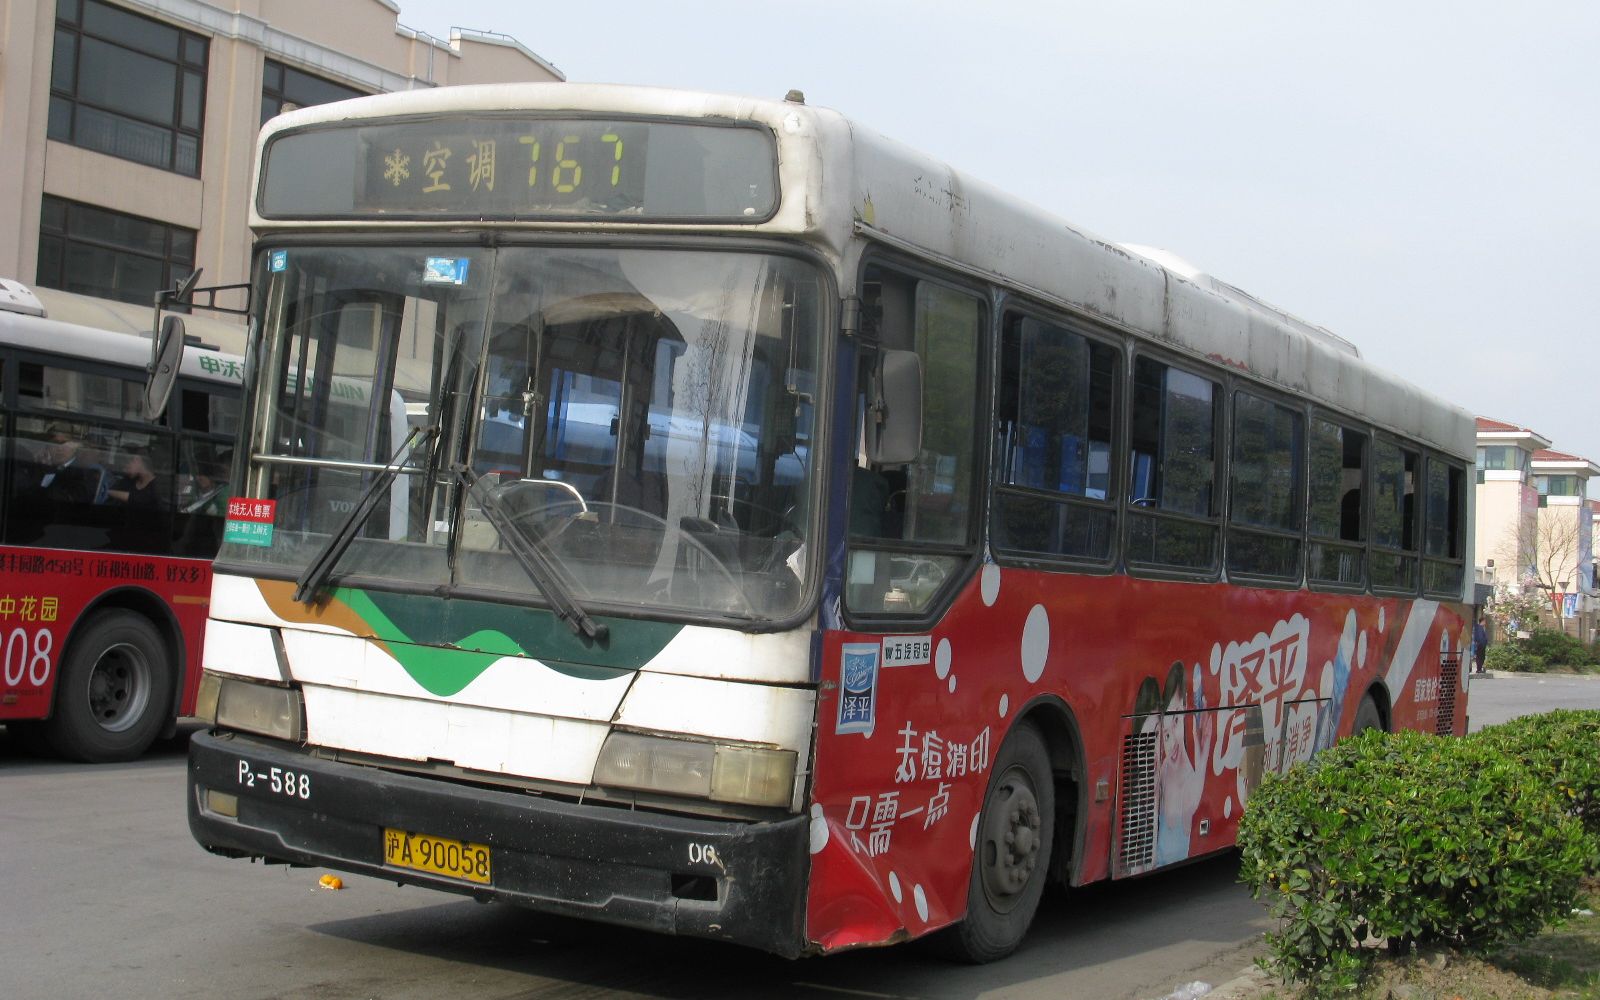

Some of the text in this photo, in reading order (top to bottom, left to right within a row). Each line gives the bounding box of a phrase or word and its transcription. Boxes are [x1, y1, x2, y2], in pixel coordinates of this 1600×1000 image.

[423, 133, 624, 193] 空调 767
[199, 355, 244, 380] 申沃
[0, 627, 52, 686] 08
[843, 696, 870, 720] 泽平
[895, 720, 990, 783] 去痘消印
[846, 782, 952, 857] 只需一点
